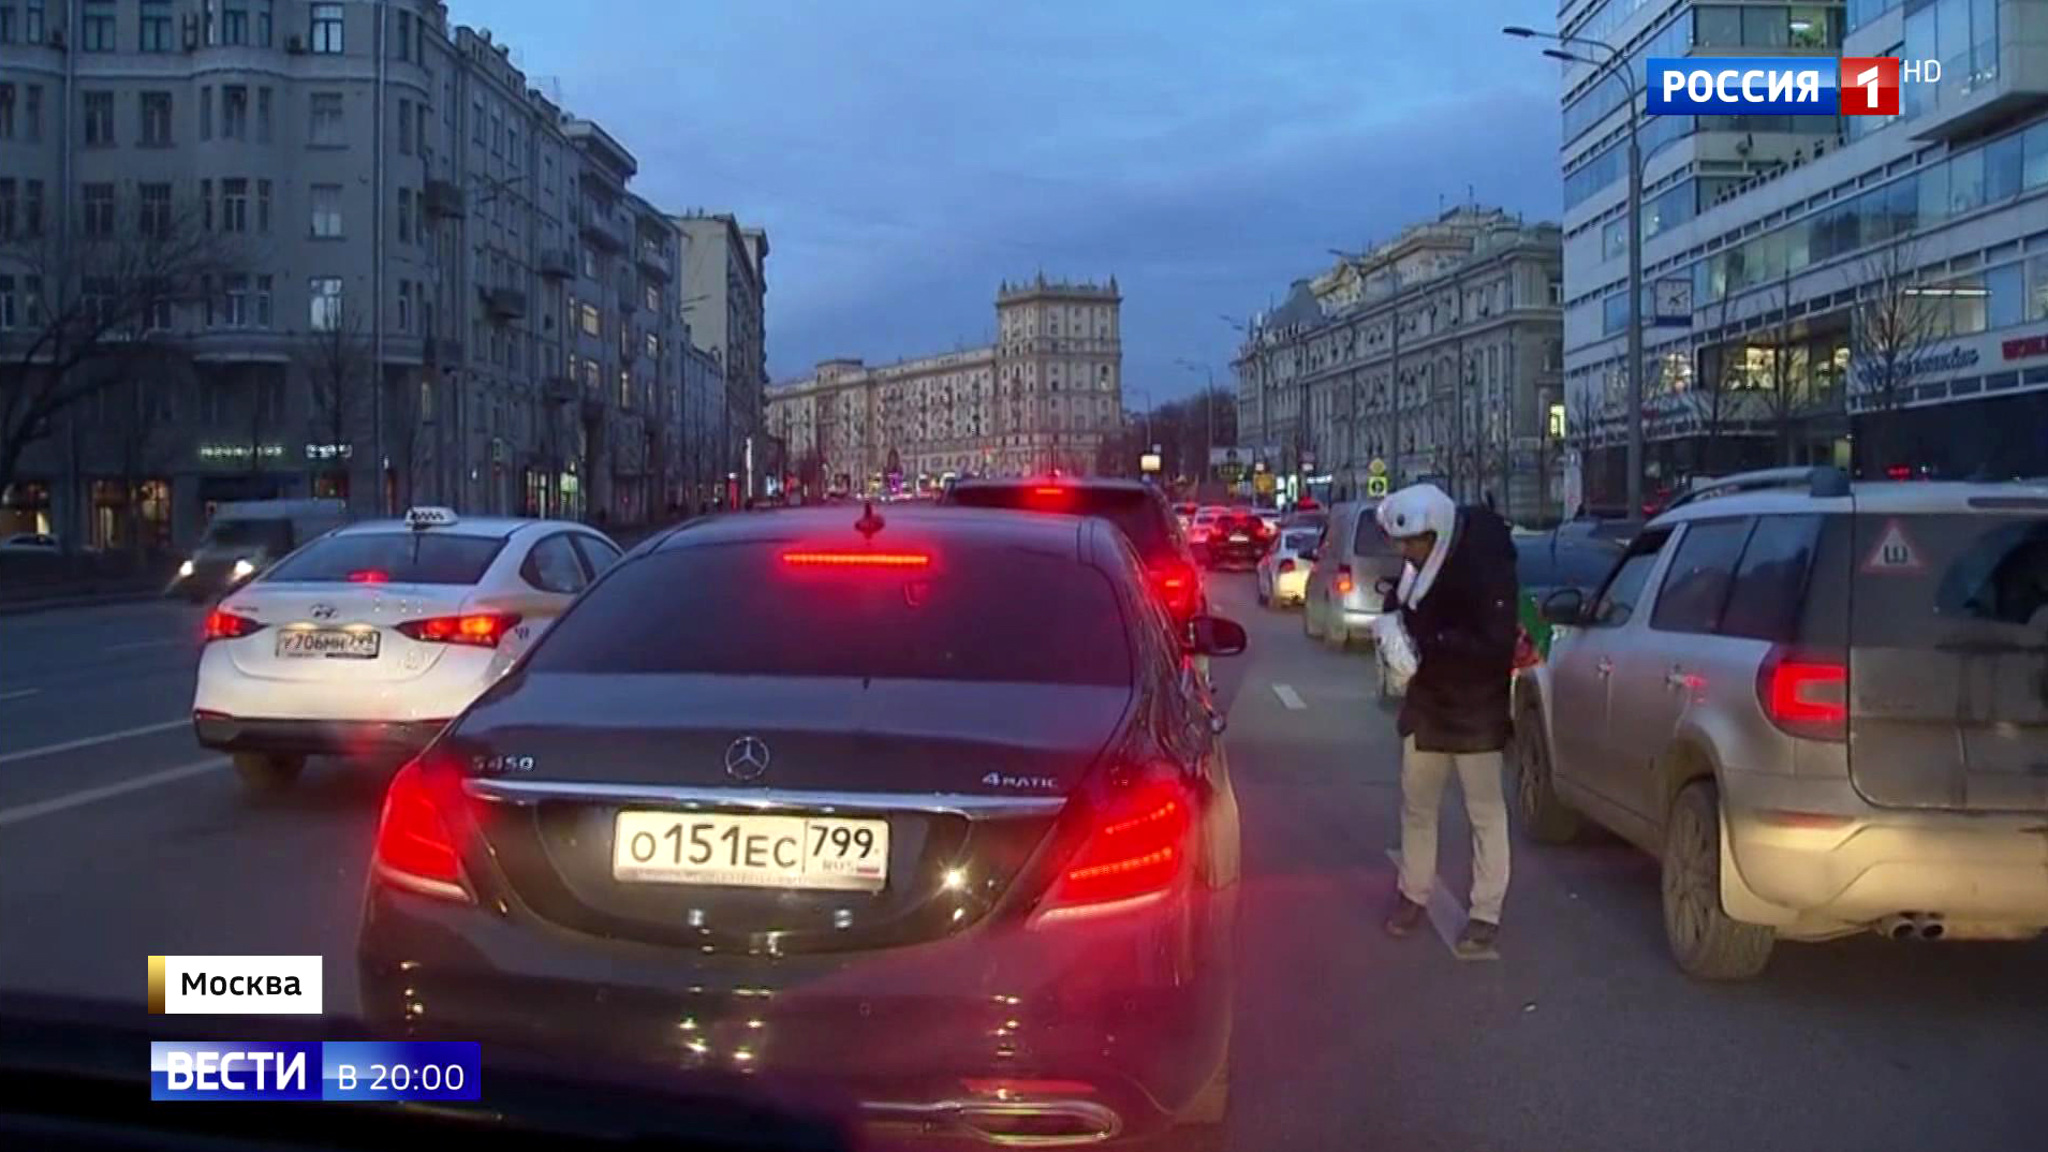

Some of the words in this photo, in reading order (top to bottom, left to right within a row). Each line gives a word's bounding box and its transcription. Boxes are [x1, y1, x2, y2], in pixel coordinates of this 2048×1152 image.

[1884, 545, 1908, 564] Ш
[631, 823, 797, 868] О151ЕС
[810, 824, 875, 859] 799
